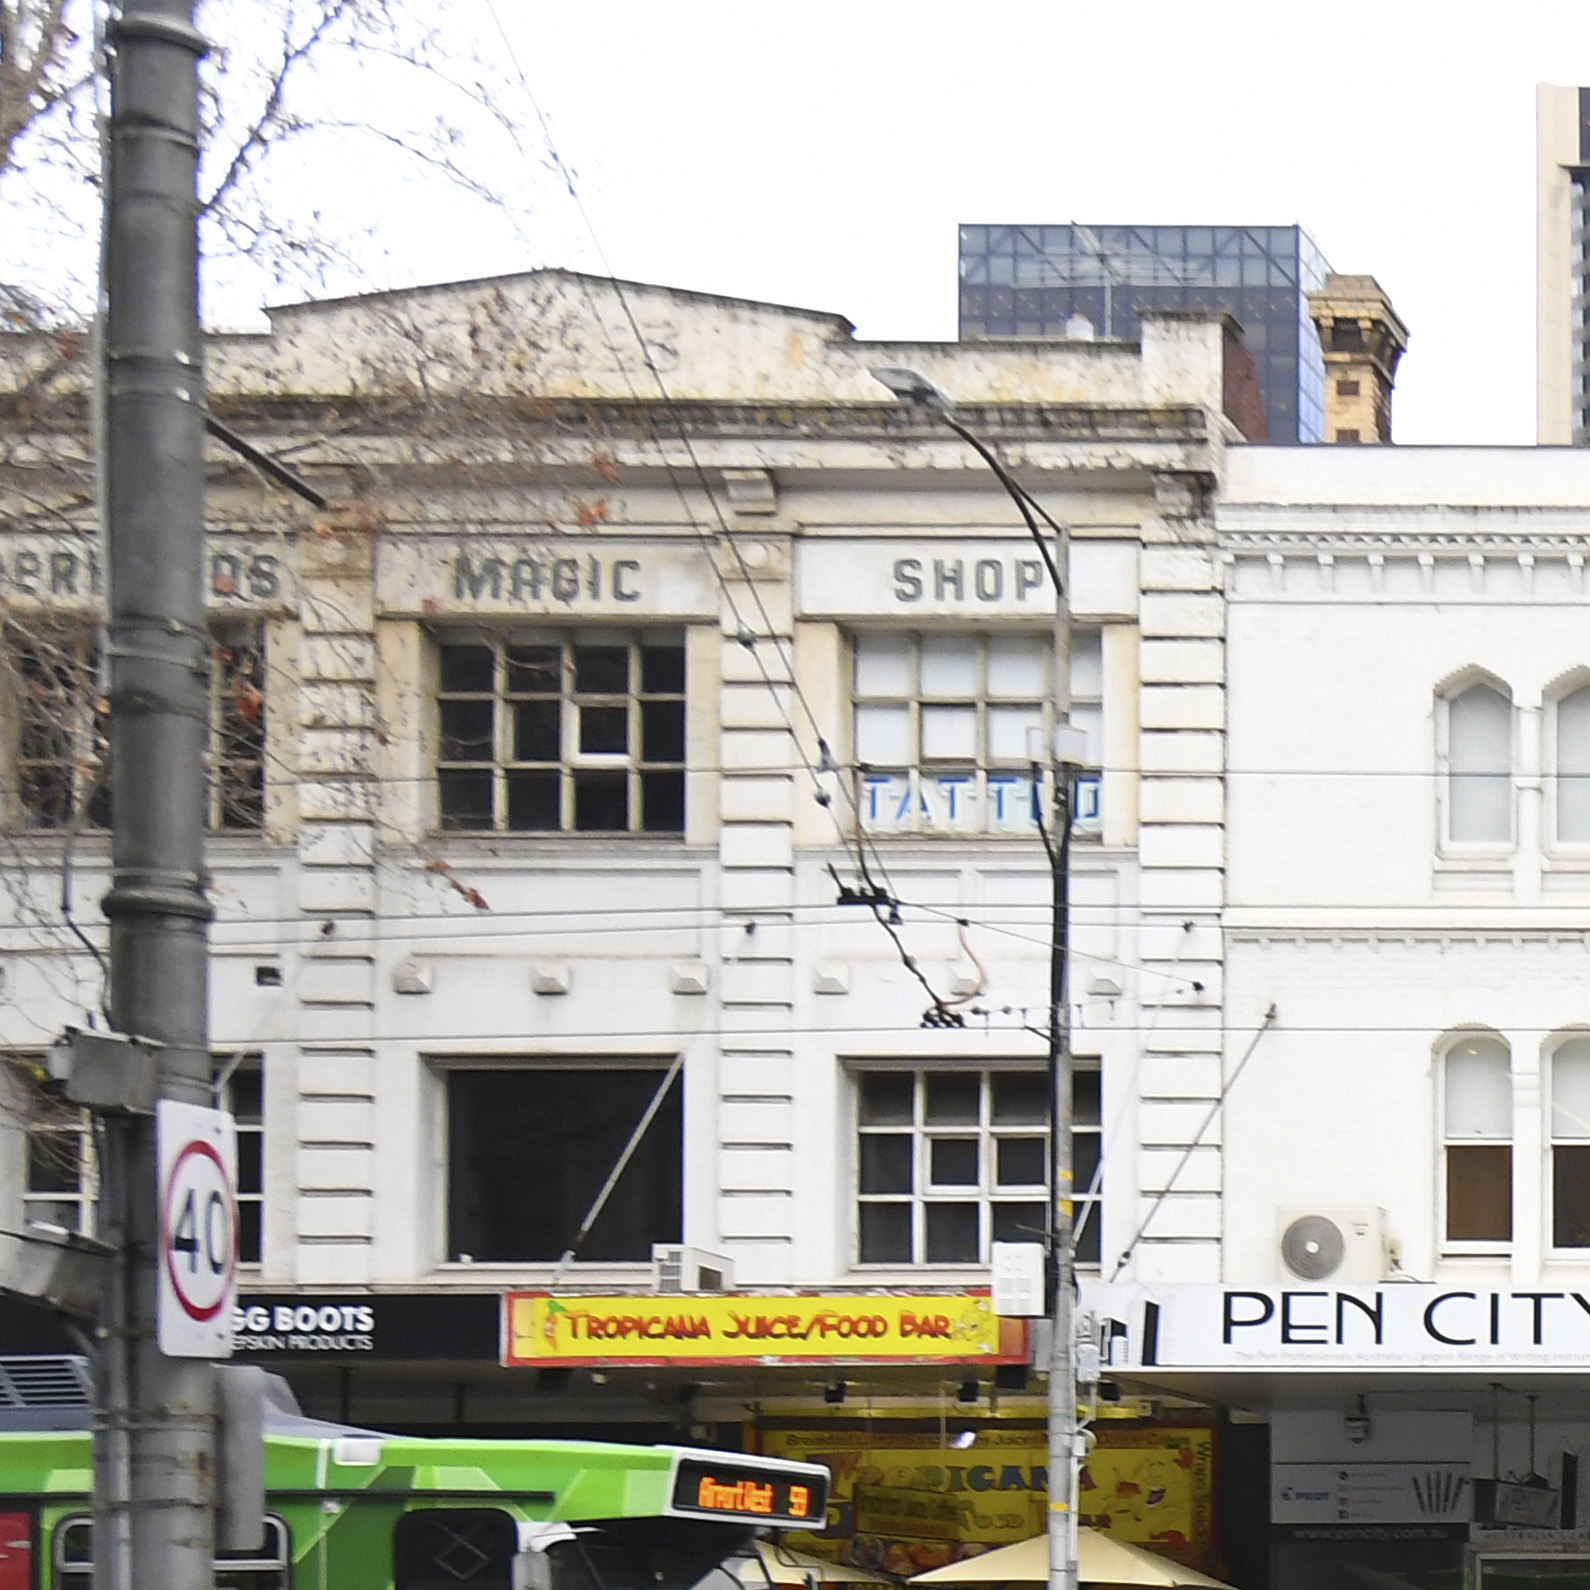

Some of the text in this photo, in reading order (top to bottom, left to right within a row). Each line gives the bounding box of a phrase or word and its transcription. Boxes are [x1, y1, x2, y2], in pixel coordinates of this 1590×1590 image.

[454, 557, 642, 602] MAGIC
[893, 559, 1043, 602] SHOP
[174, 1188, 226, 1275] 40
[274, 1306, 374, 1332] BOOTS
[564, 1310, 952, 1340] TROPICANA JUICE/FOOD BAR
[1222, 1291, 1385, 1345] PEN
[288, 1334, 374, 1350] PRODUCTS
